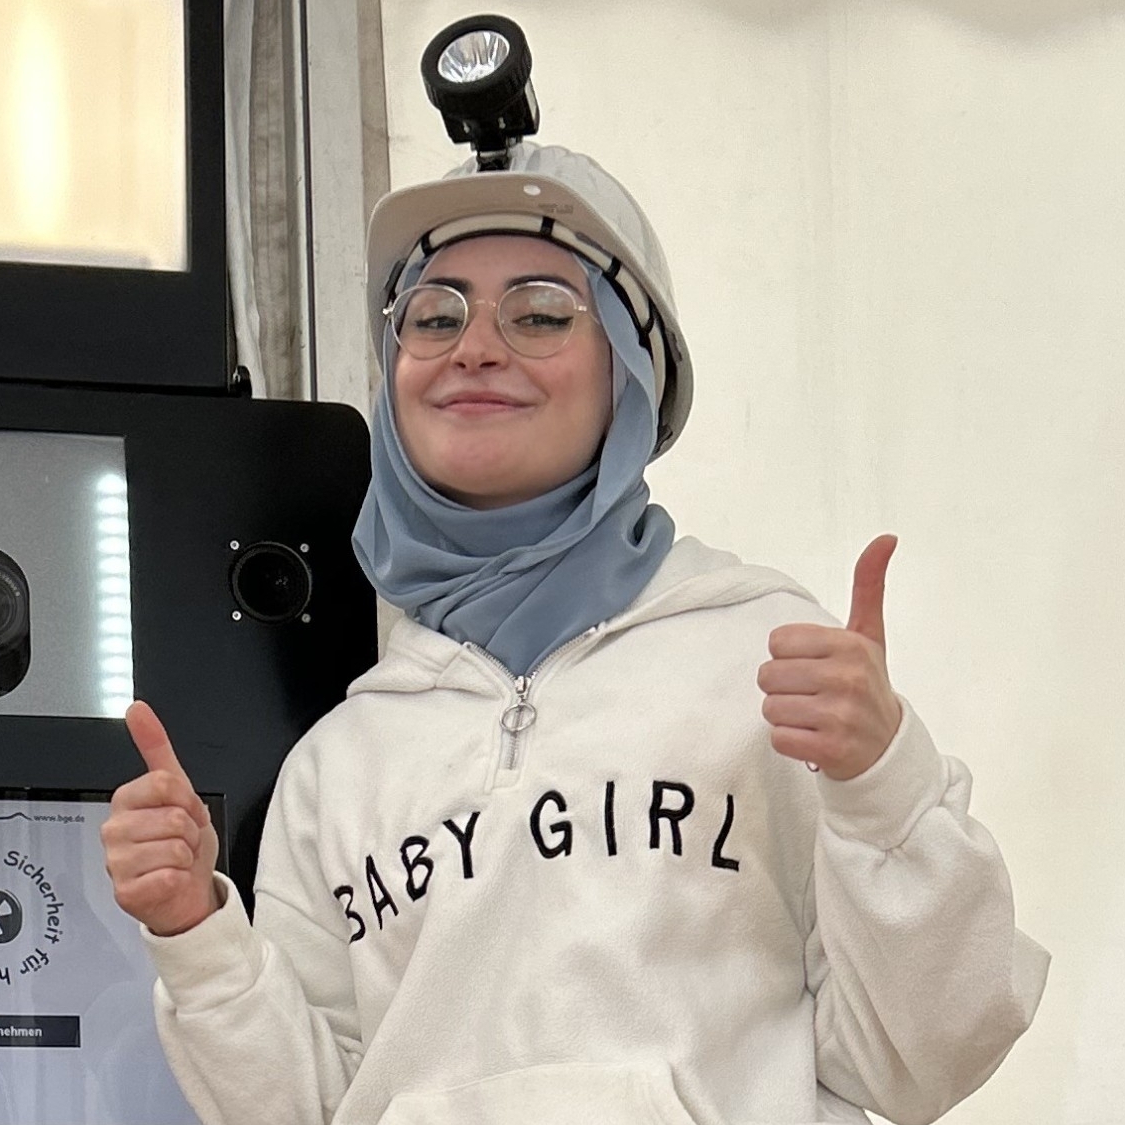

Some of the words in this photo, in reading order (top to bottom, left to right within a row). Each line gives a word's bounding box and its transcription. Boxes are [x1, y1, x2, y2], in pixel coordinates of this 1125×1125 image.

[33, 814, 85, 824] www.bge.de
[333, 811, 481, 944] BABY
[529, 780, 740, 872] GIRL
[3, 850, 64, 944] Sicherheit
[20, 948, 50, 975] für
